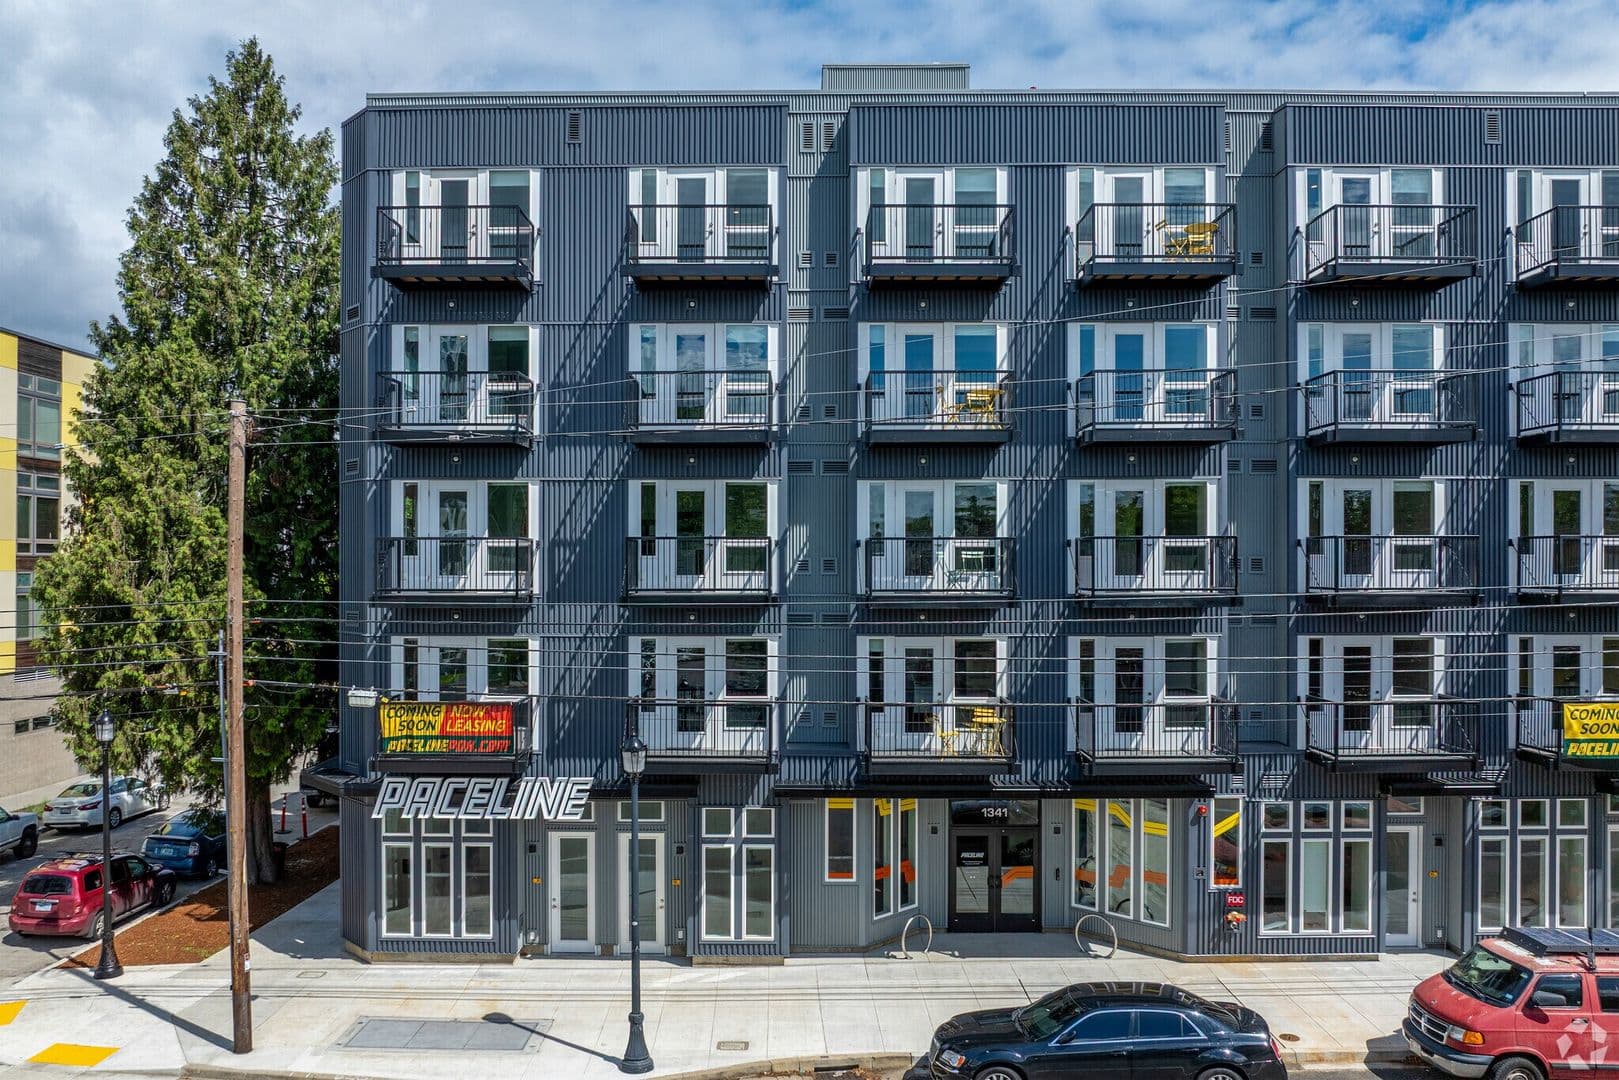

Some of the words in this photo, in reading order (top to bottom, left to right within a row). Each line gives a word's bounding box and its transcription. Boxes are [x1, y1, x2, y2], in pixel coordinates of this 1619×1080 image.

[386, 704, 441, 719] COMING
[451, 705, 488, 717] NOW
[1570, 708, 1619, 720] COMIN
[398, 720, 437, 732] SOON
[446, 719, 506, 733] LEASING
[1580, 723, 1619, 735] SOON
[371, 776, 594, 820] PACELINE
[981, 808, 1008, 818] 1341
[1227, 896, 1244, 904] FDC
